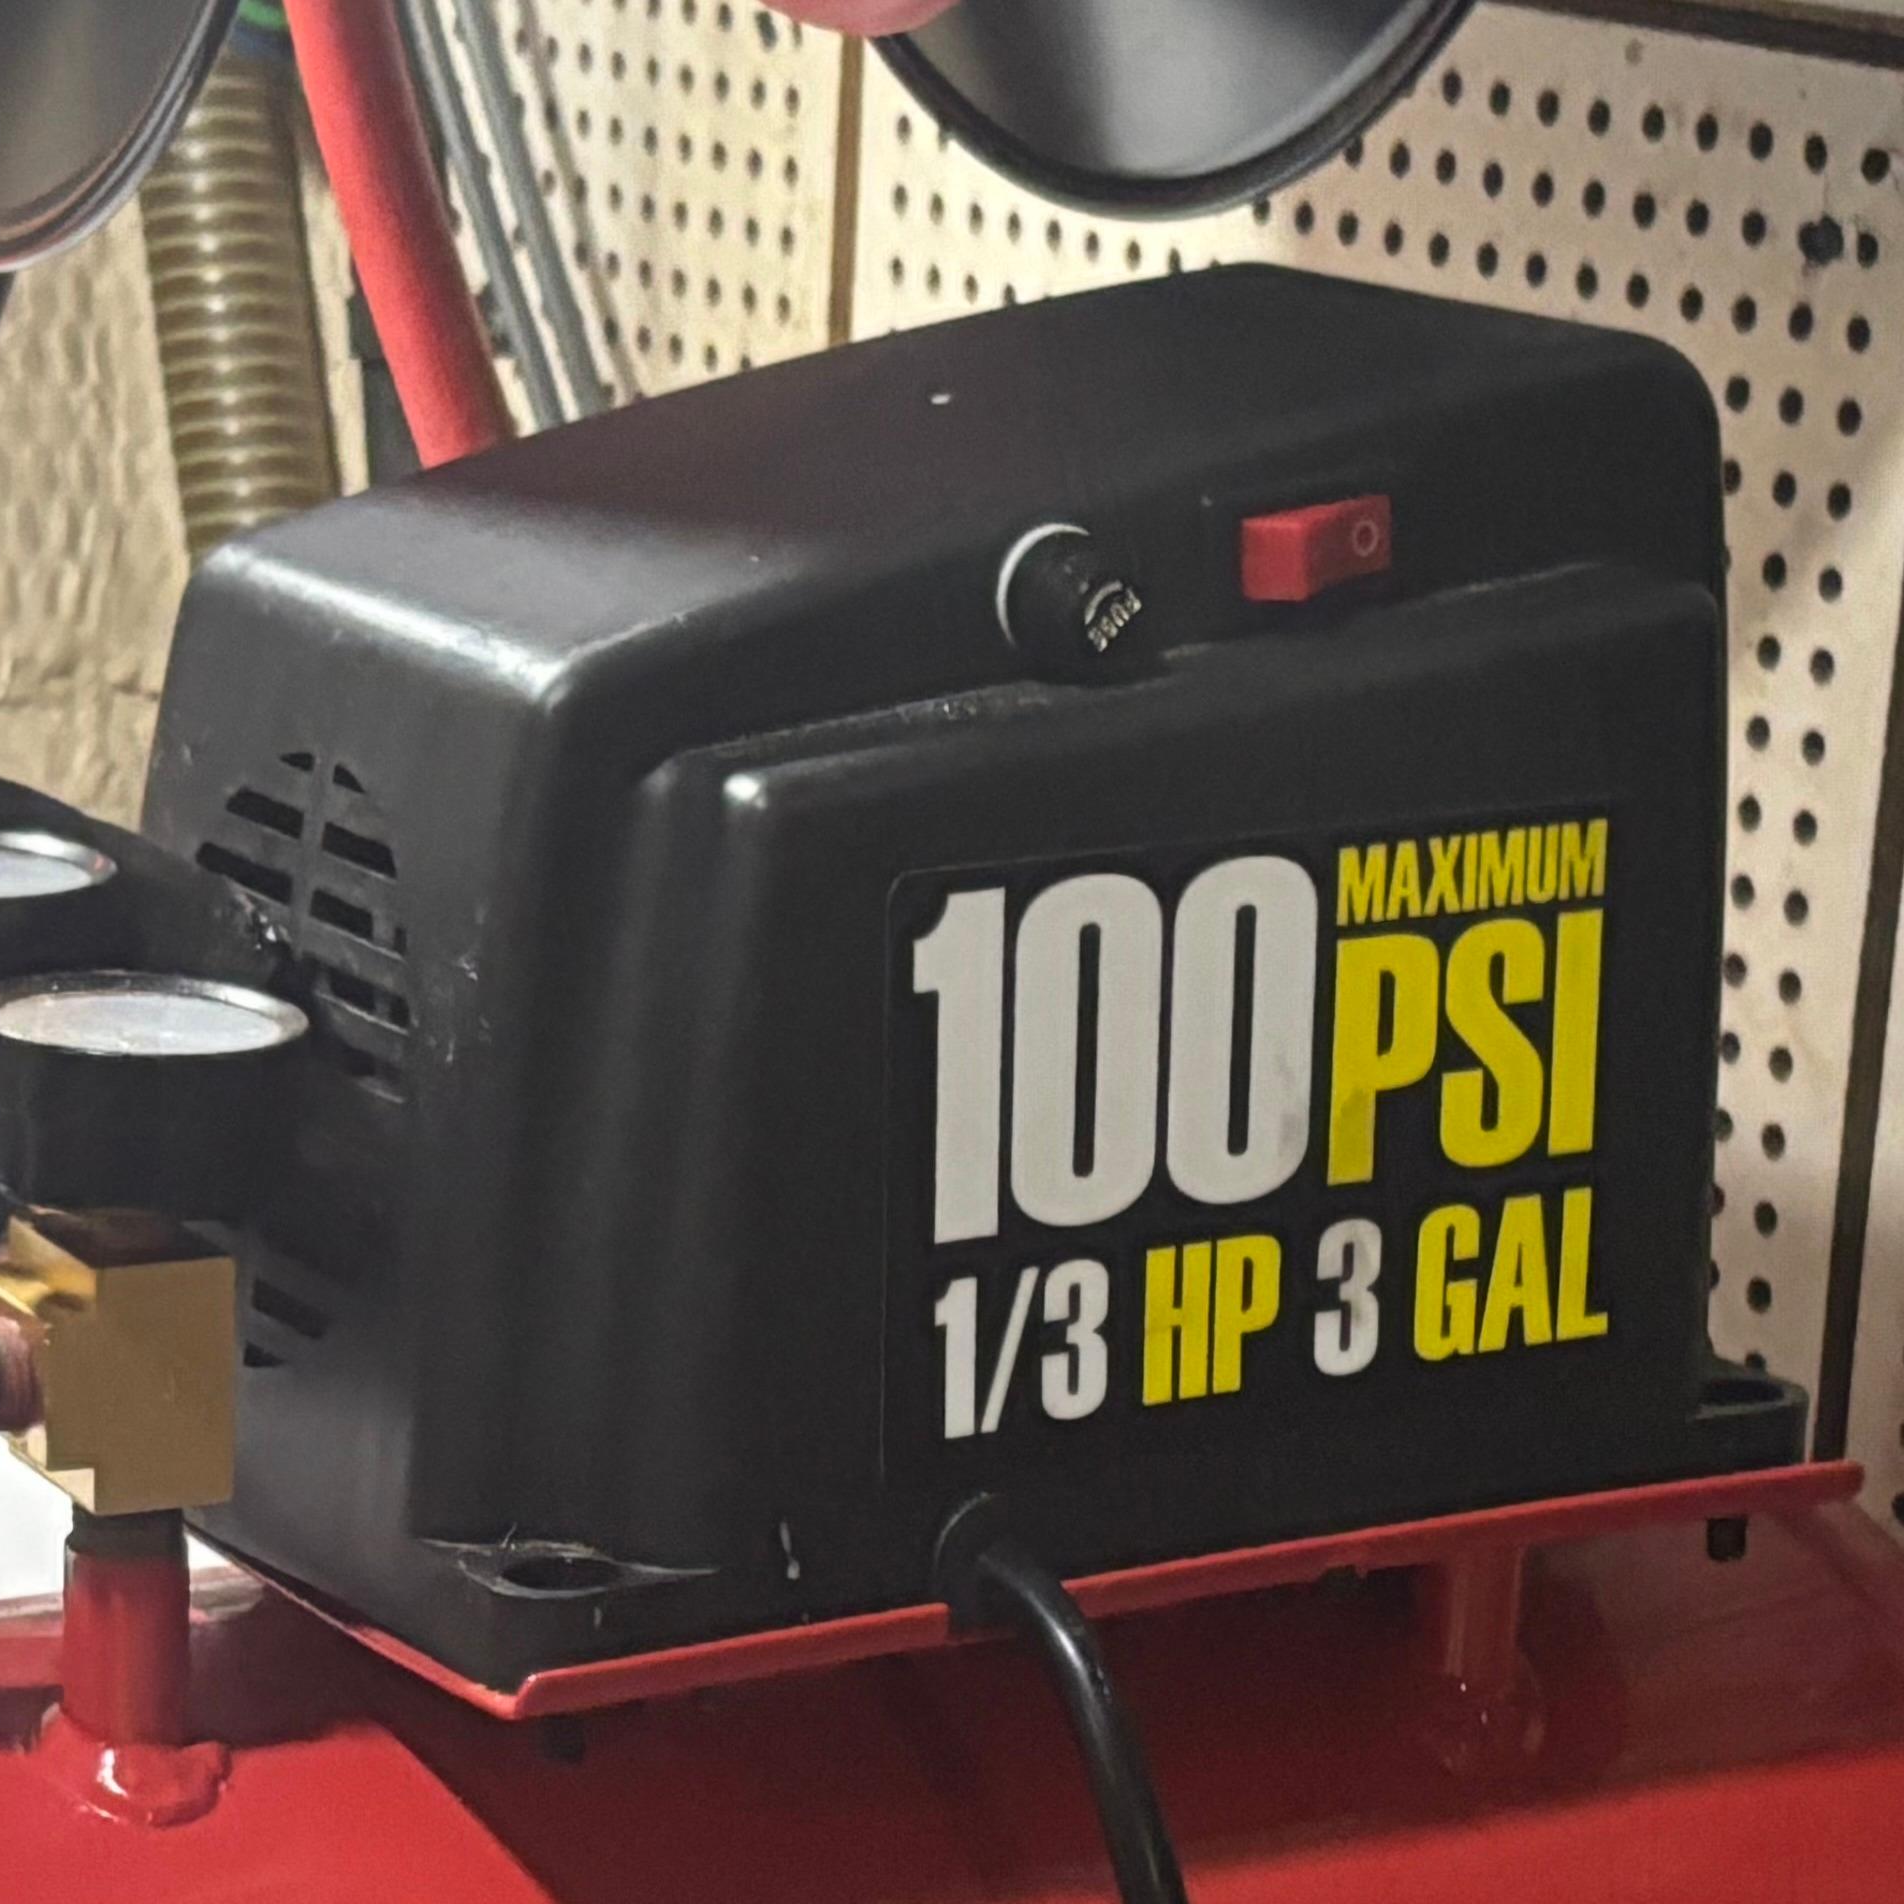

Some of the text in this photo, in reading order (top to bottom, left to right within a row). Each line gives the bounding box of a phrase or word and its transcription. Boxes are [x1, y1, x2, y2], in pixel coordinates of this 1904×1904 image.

[1336, 818, 1609, 927] MAXIMUM
[913, 855, 1318, 1244] 100
[1327, 908, 1604, 1186] PSI
[934, 1186, 1609, 1440] 1/3 HP 3 GAL
